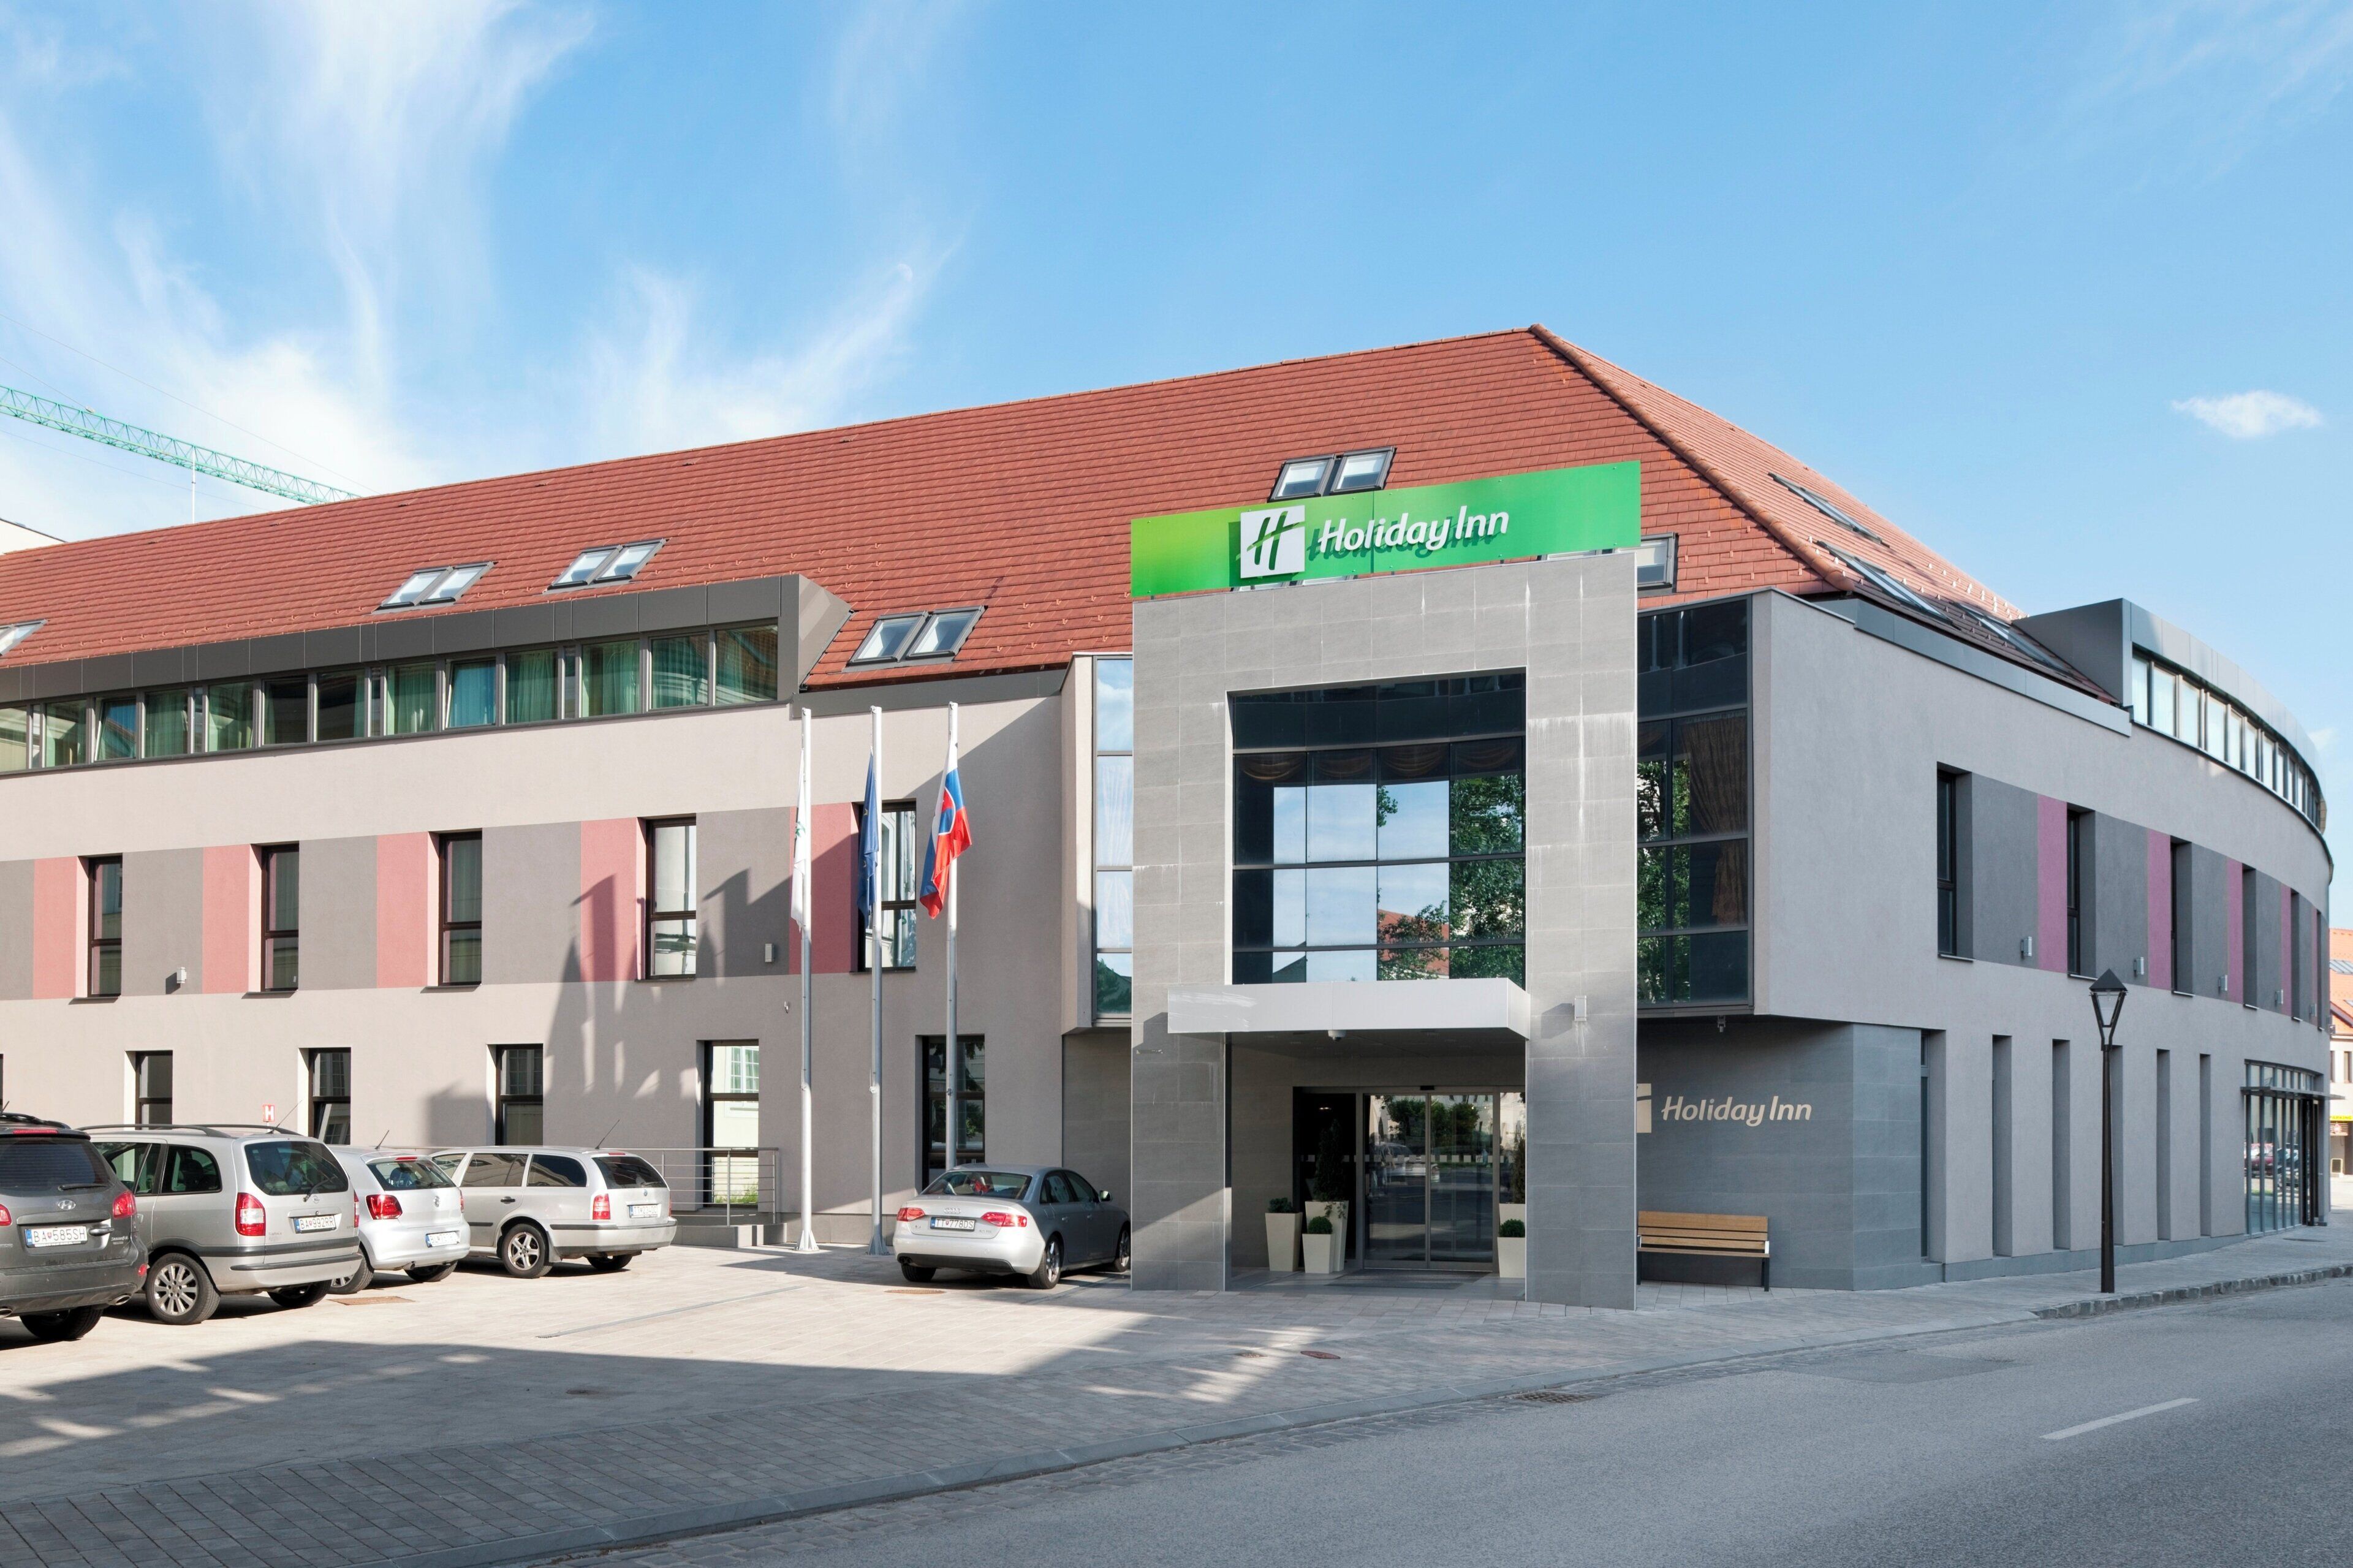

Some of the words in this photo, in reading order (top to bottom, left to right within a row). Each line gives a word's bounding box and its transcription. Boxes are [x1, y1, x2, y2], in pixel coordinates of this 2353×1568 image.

[1317, 513, 1450, 553] Holiday
[1455, 505, 1509, 539] Inn
[1661, 1096, 1765, 1127] Holiday
[1769, 1096, 1812, 1121] Inn
